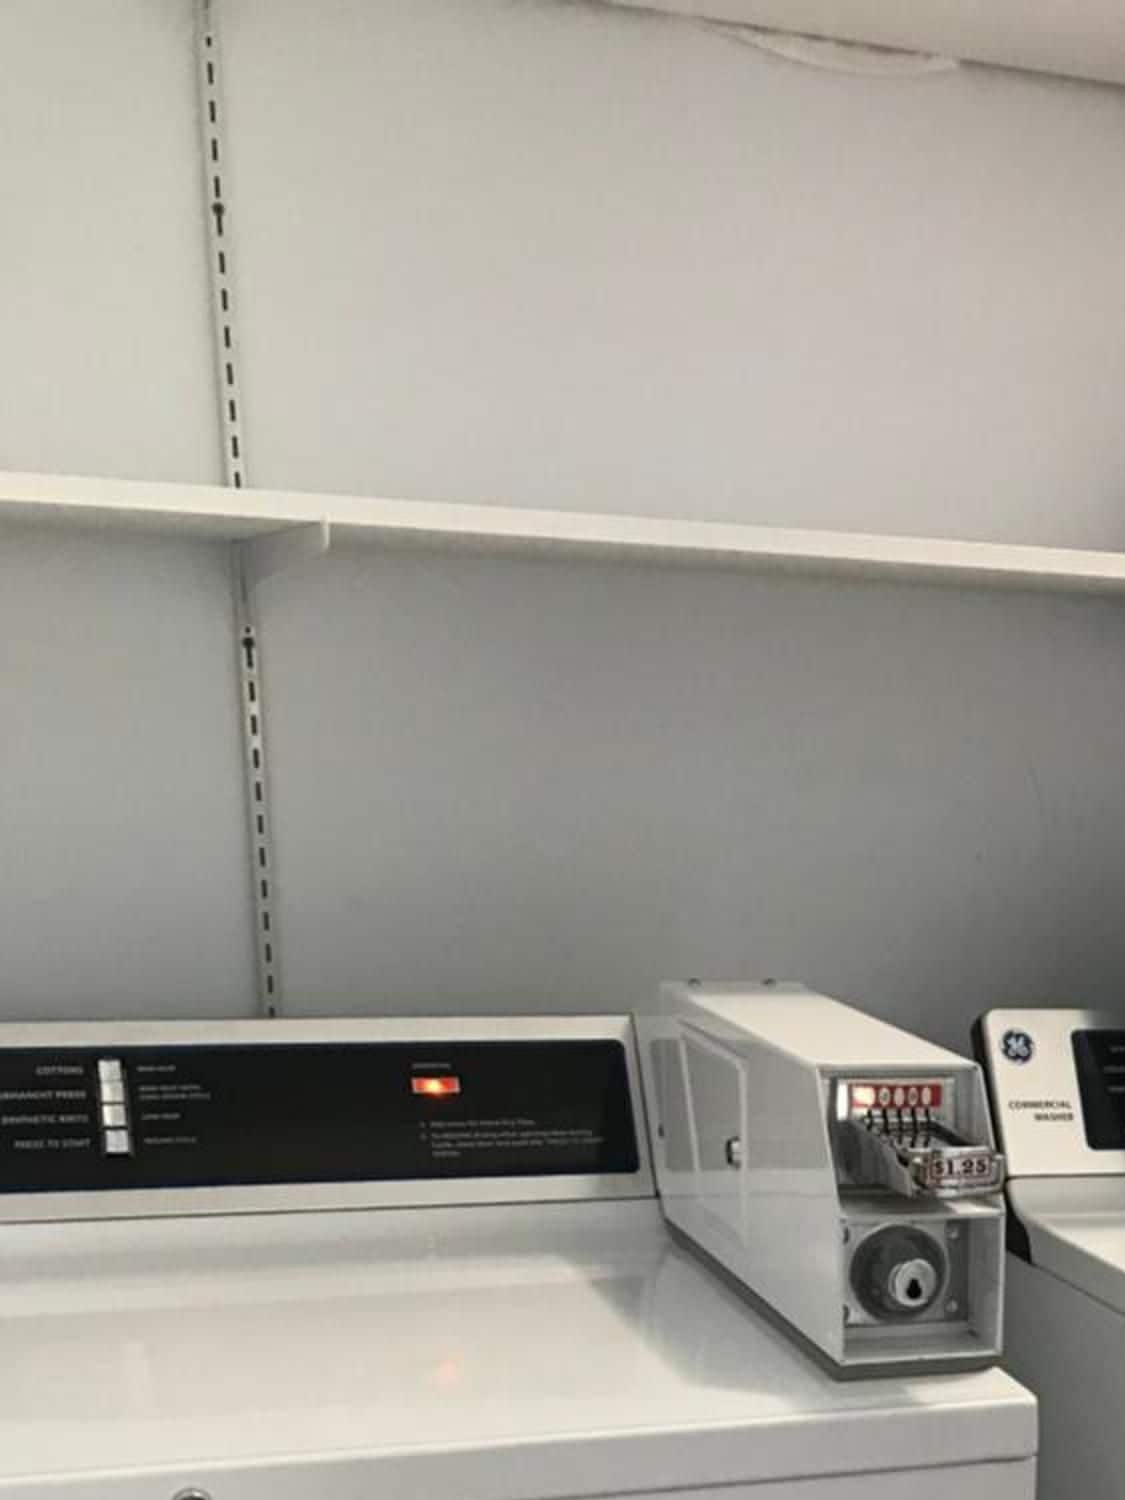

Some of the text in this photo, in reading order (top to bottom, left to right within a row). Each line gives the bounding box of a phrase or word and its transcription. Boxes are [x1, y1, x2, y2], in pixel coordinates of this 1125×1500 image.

[1008, 1100, 1072, 1110] COMMERCIAL
[1034, 1112, 1074, 1122] WASHER
[935, 1158, 987, 1175] $1.25
